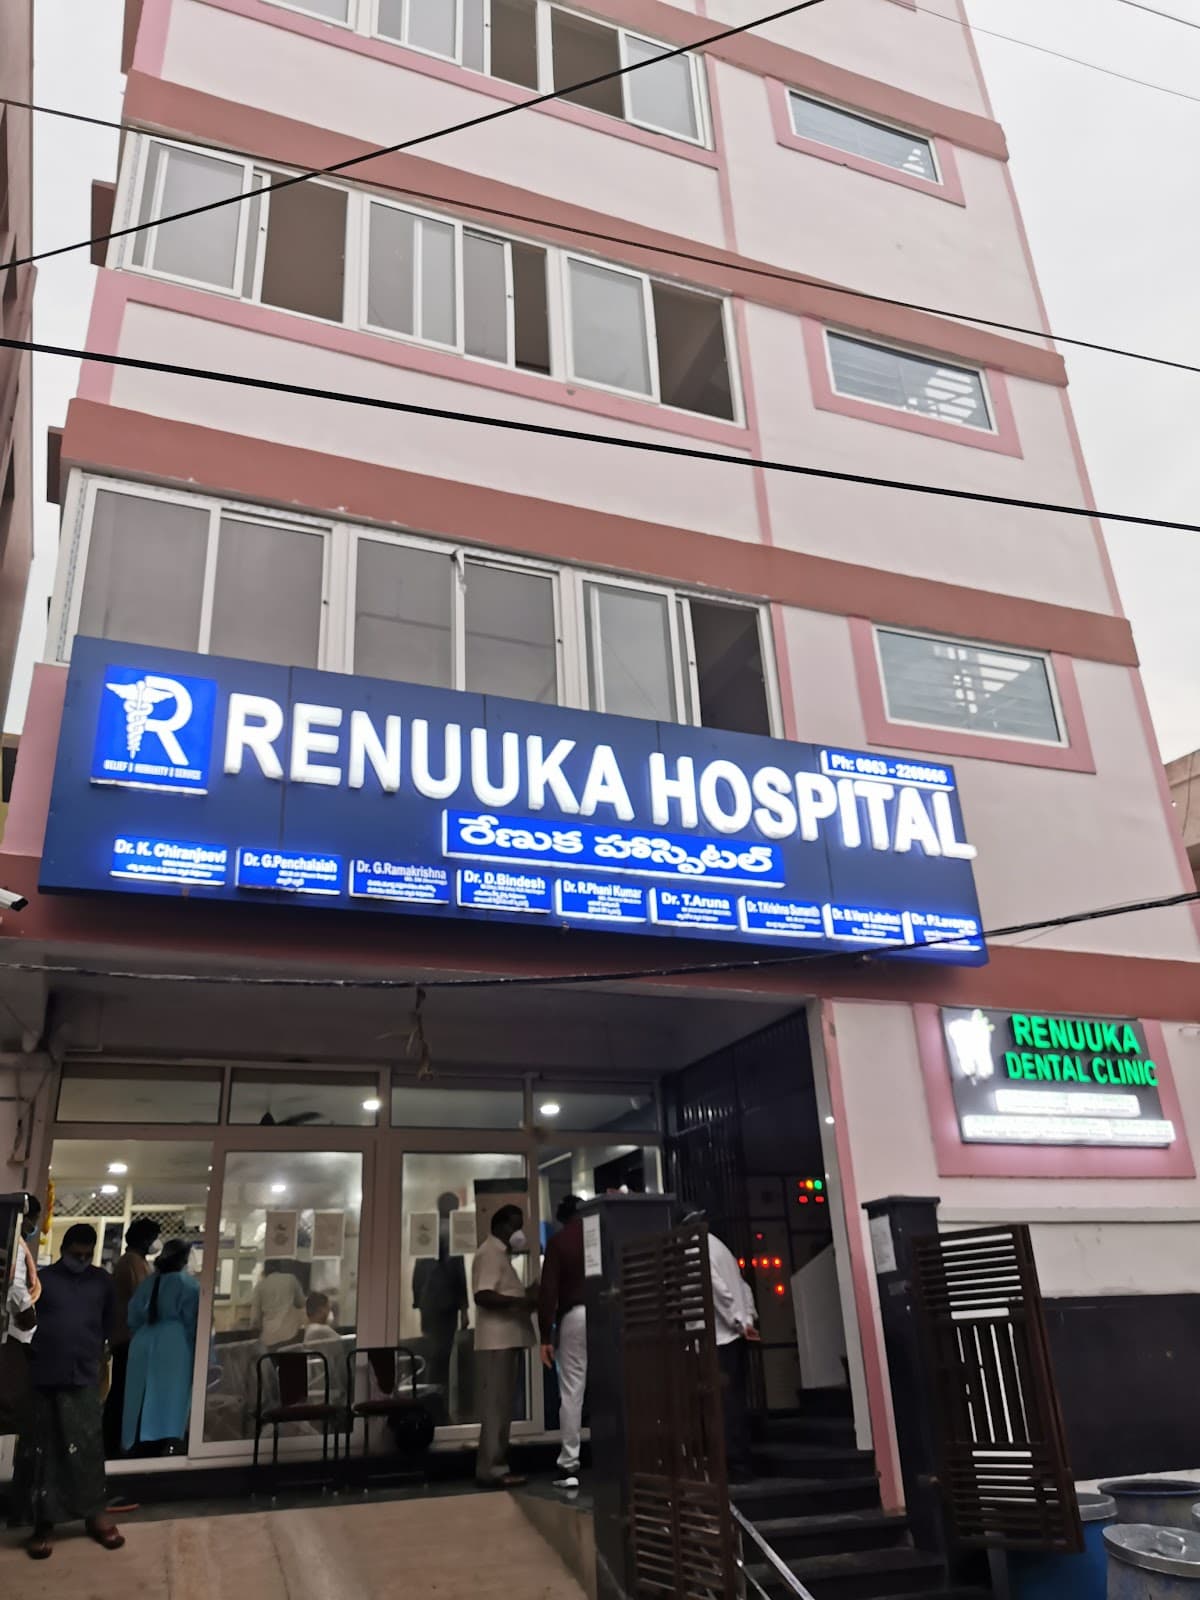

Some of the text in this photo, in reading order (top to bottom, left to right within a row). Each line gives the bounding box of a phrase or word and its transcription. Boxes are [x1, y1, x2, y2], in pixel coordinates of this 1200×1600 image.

[224, 692, 978, 860] RENUUKA HOSPITAL
[458, 815, 584, 854] రేణుక
[115, 839, 227, 863] Dr. K. Chiranjeevi
[244, 853, 260, 866] Dr.
[356, 860, 447, 880] Dr. G.Ramakrishna
[464, 870, 482, 883] Dr.
[484, 872, 546, 889] D.Bindesh
[563, 880, 577, 893] Dr.
[613, 885, 643, 899] Kumar
[661, 892, 731, 910] Dr. T.Aruna
[911, 913, 927, 925] Dr.
[1010, 1013, 1141, 1055] RENUUKA
[1004, 1051, 1159, 1087] DENTAL CLINIC
